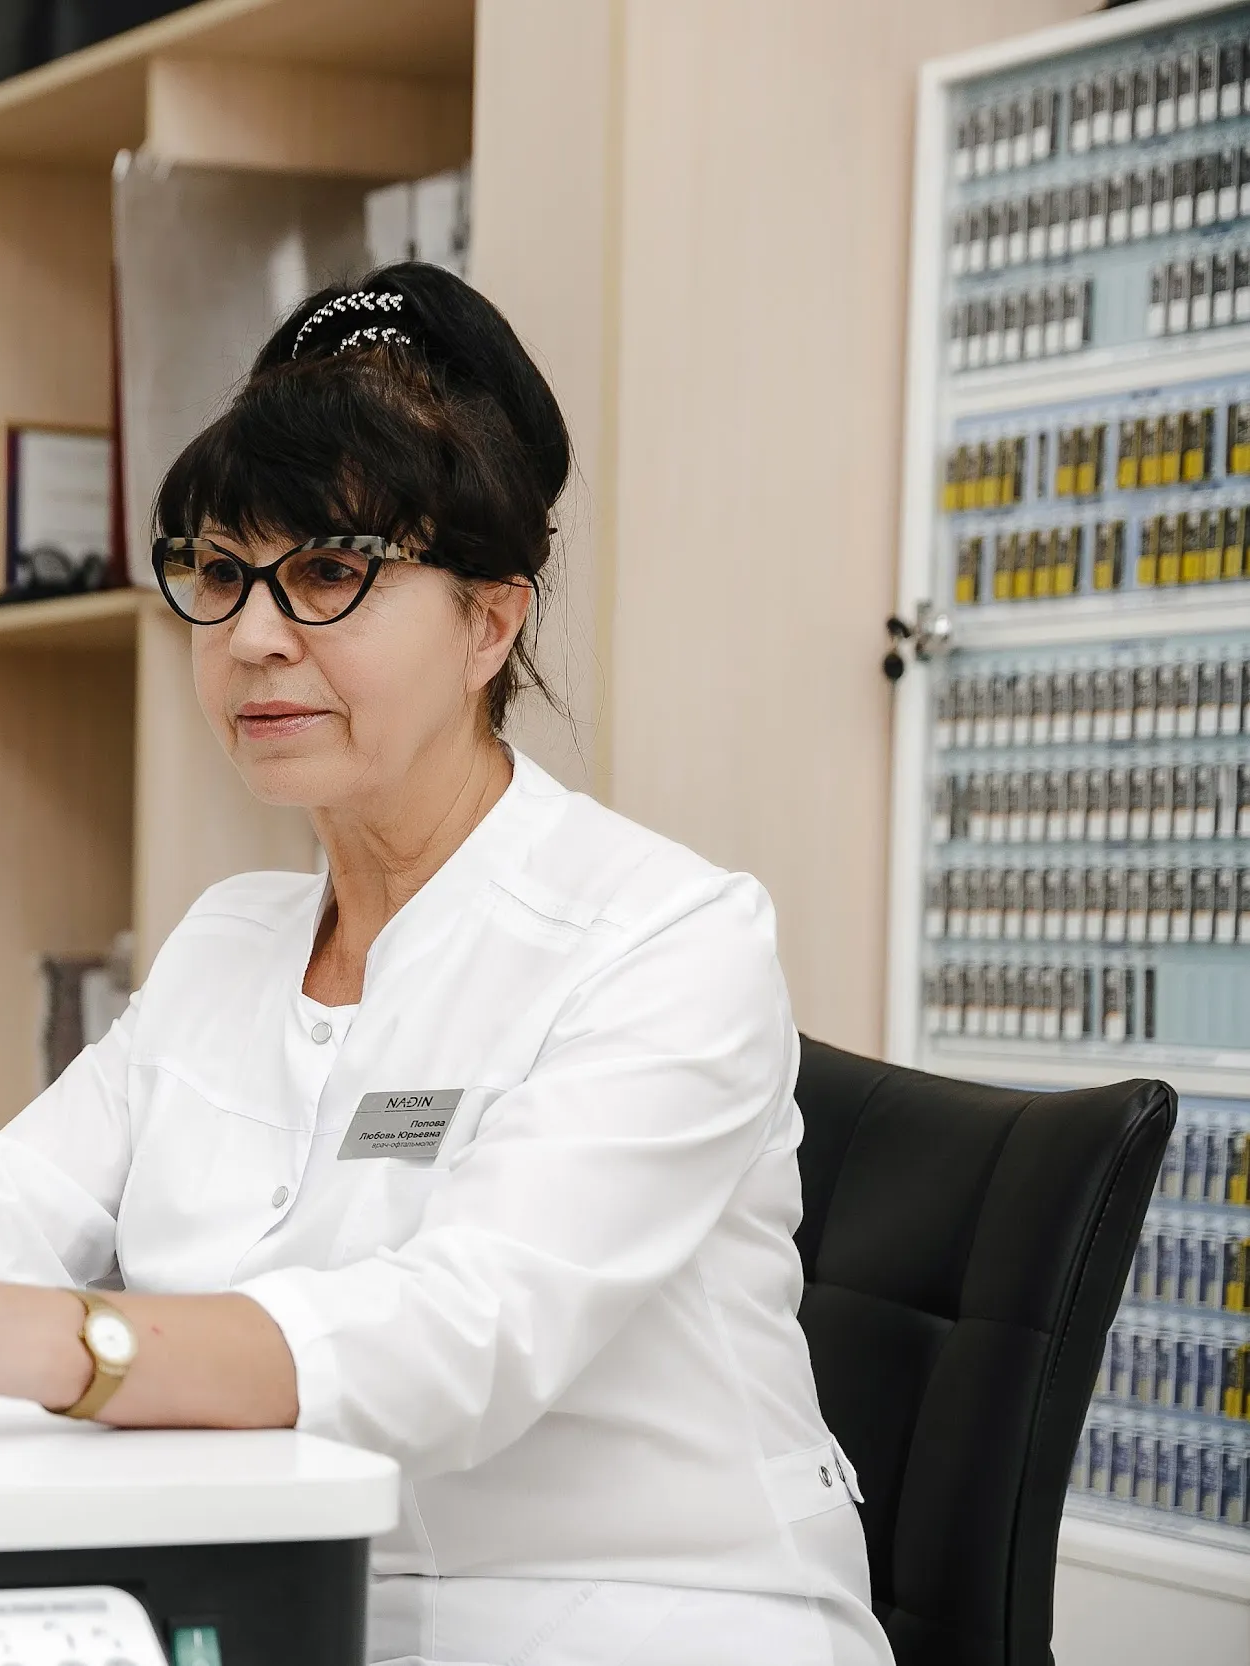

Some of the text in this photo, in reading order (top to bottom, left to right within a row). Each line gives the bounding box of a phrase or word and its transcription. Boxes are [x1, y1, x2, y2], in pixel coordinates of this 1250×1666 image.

[410, 1119, 446, 1129] Попова
[359, 1130, 441, 1141] Любовь Юрьевна
[371, 1140, 438, 1150] врач-офтальмолог
